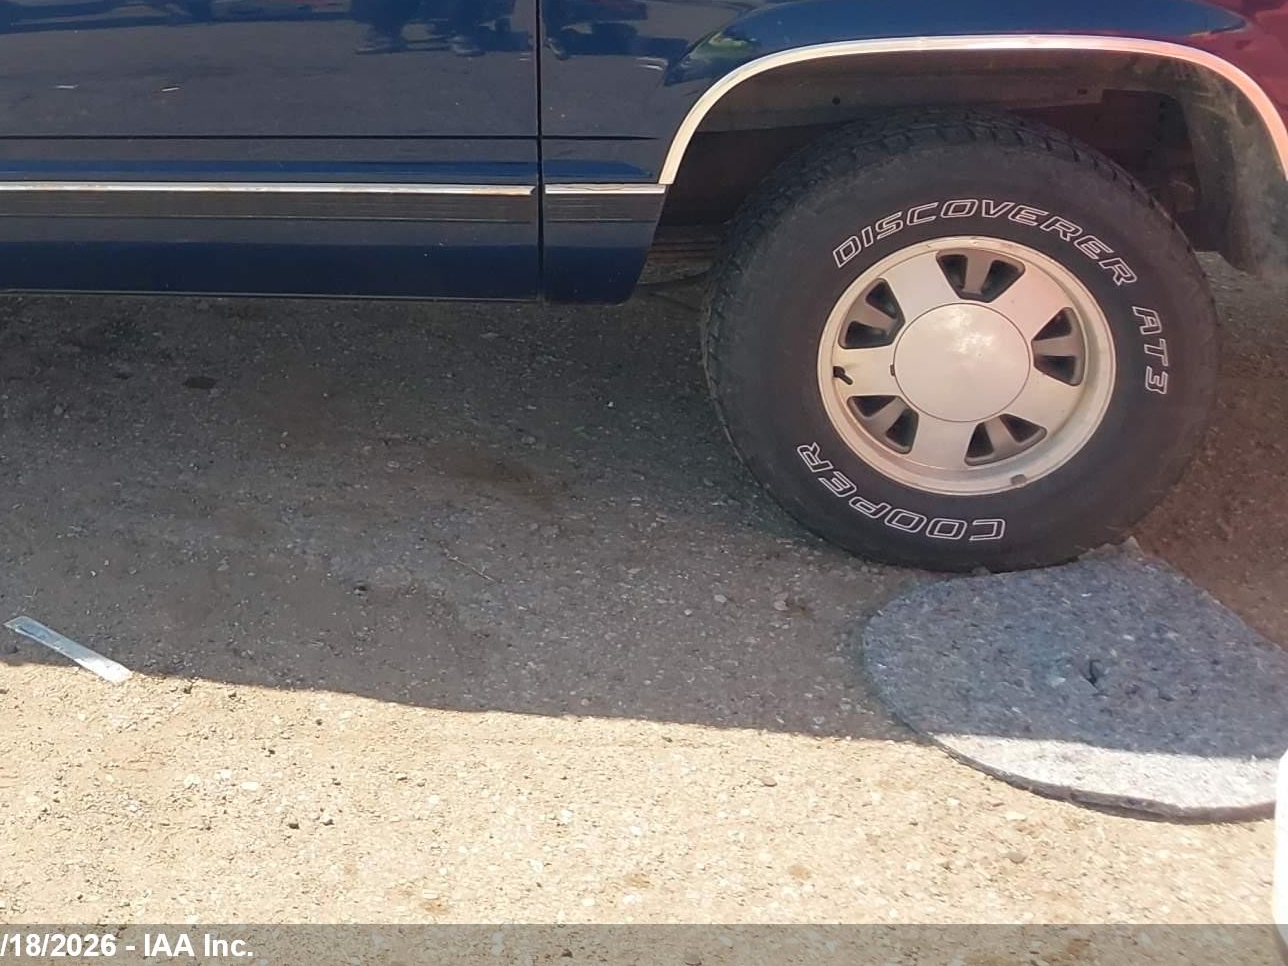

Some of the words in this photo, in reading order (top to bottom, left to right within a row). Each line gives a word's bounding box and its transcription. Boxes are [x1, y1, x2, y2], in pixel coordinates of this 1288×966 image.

[832, 199, 1137, 286] DISCOVERER
[1132, 306, 1169, 395] AT3
[796, 442, 1006, 542] COOPER
